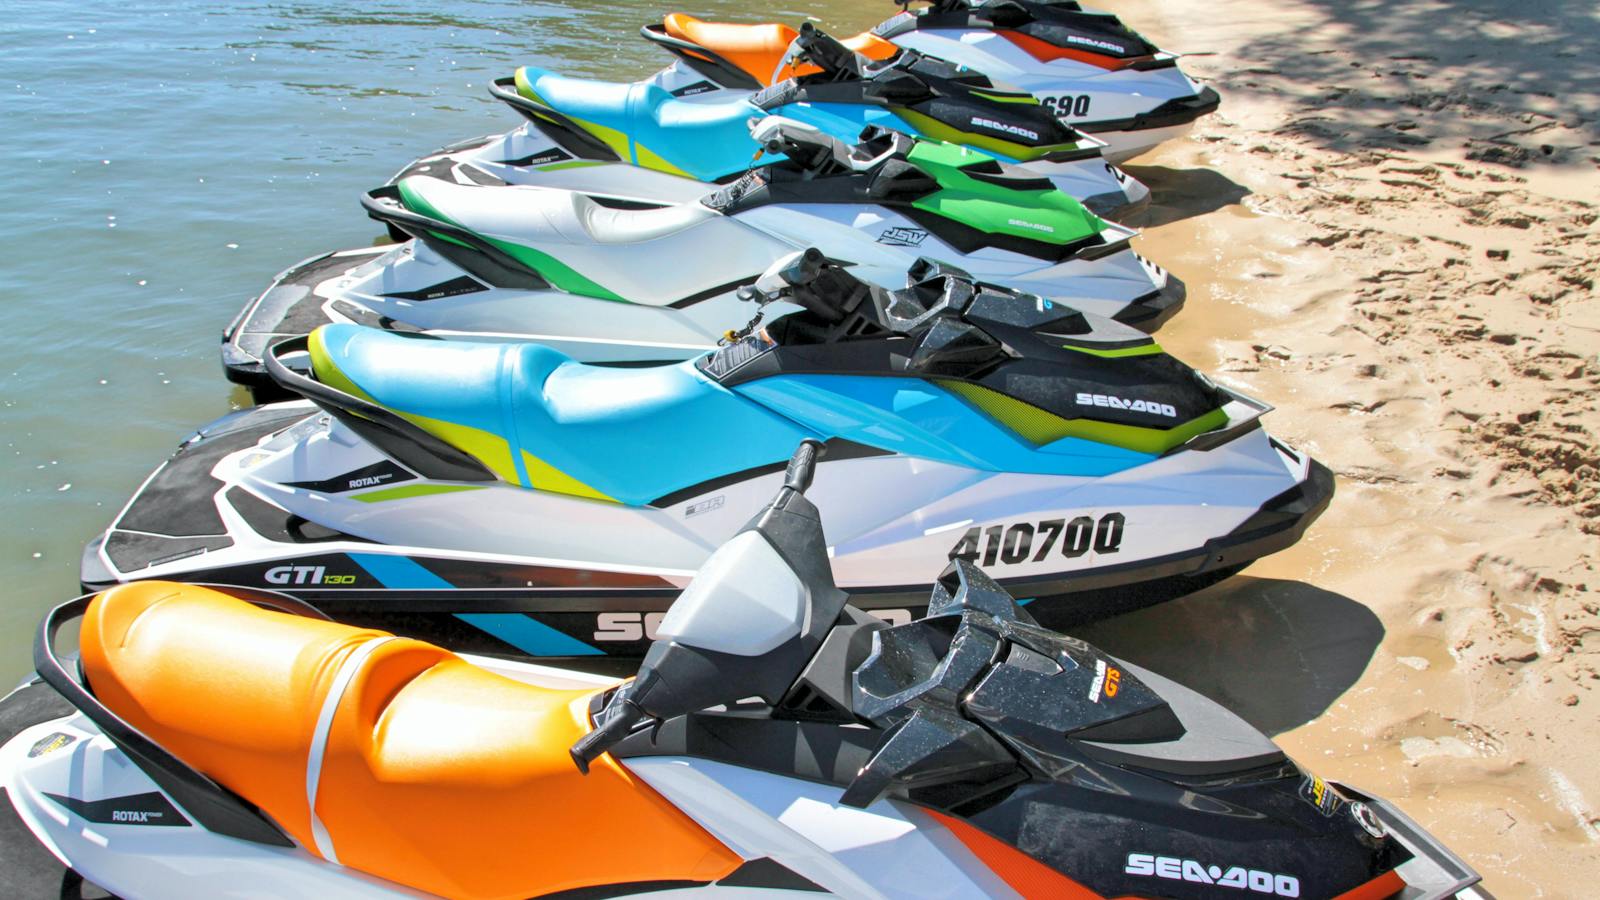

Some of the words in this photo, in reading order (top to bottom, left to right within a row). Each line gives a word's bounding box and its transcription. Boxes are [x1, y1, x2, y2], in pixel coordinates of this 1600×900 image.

[348, 476, 380, 489] ROTAX
[948, 512, 1126, 567] 41070Q
[264, 566, 326, 585] GTI
[323, 575, 356, 585] 130
[1105, 666, 1121, 698] GTS
[112, 810, 148, 822] ROTAX
